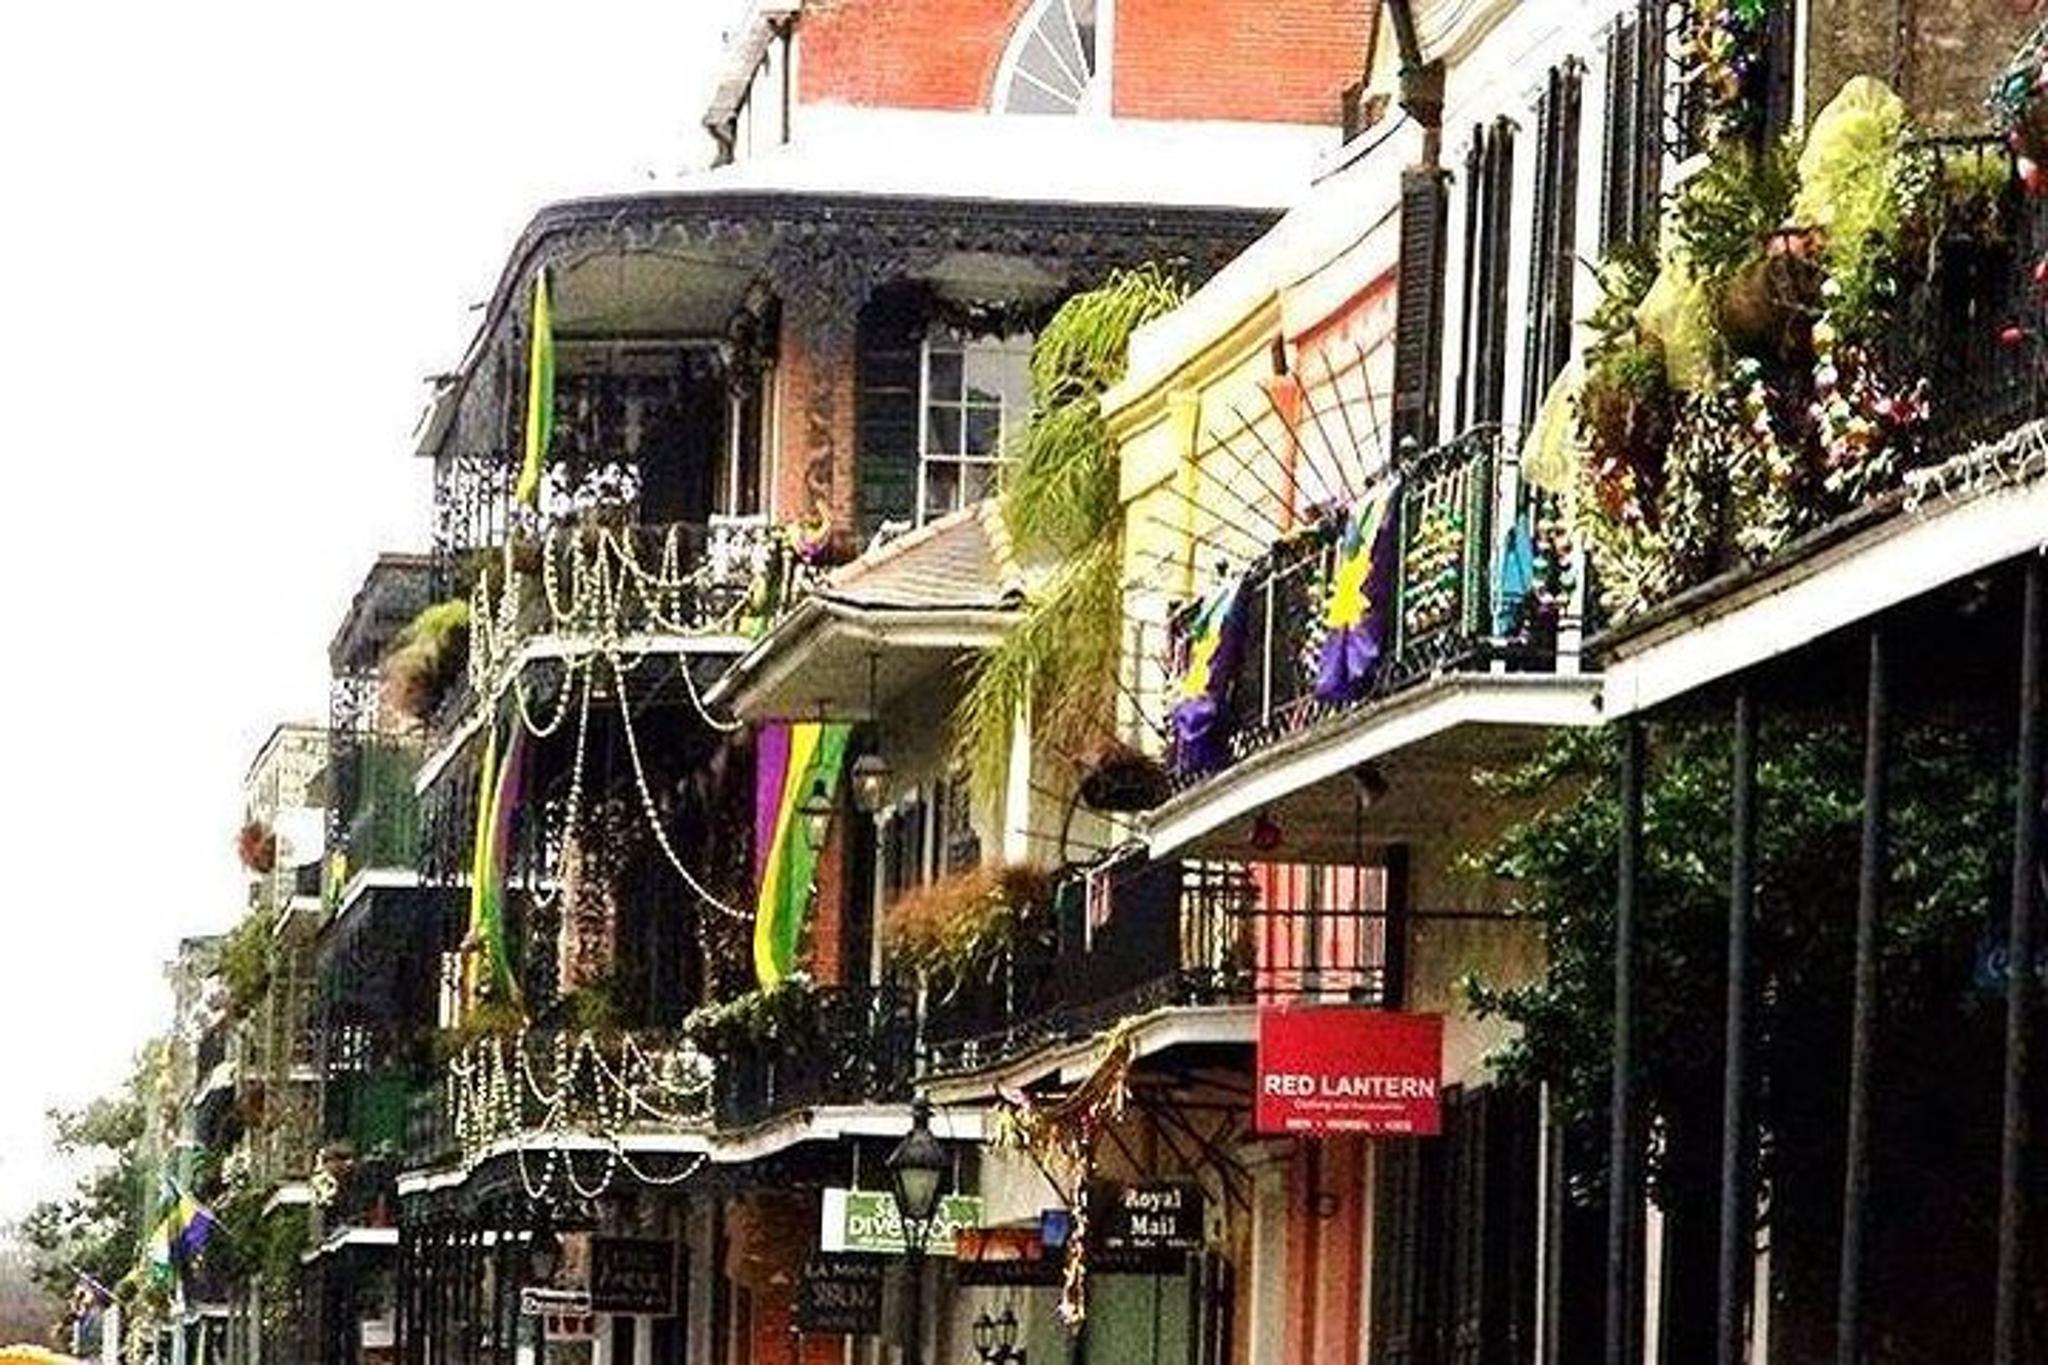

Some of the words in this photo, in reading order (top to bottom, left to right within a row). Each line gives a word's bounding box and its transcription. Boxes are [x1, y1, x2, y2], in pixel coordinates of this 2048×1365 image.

[1265, 1074, 1315, 1096] RED
[1321, 1076, 1436, 1098] LANTERN
[1125, 1188, 1182, 1213] Royal
[1130, 1214, 1176, 1235] Mail
